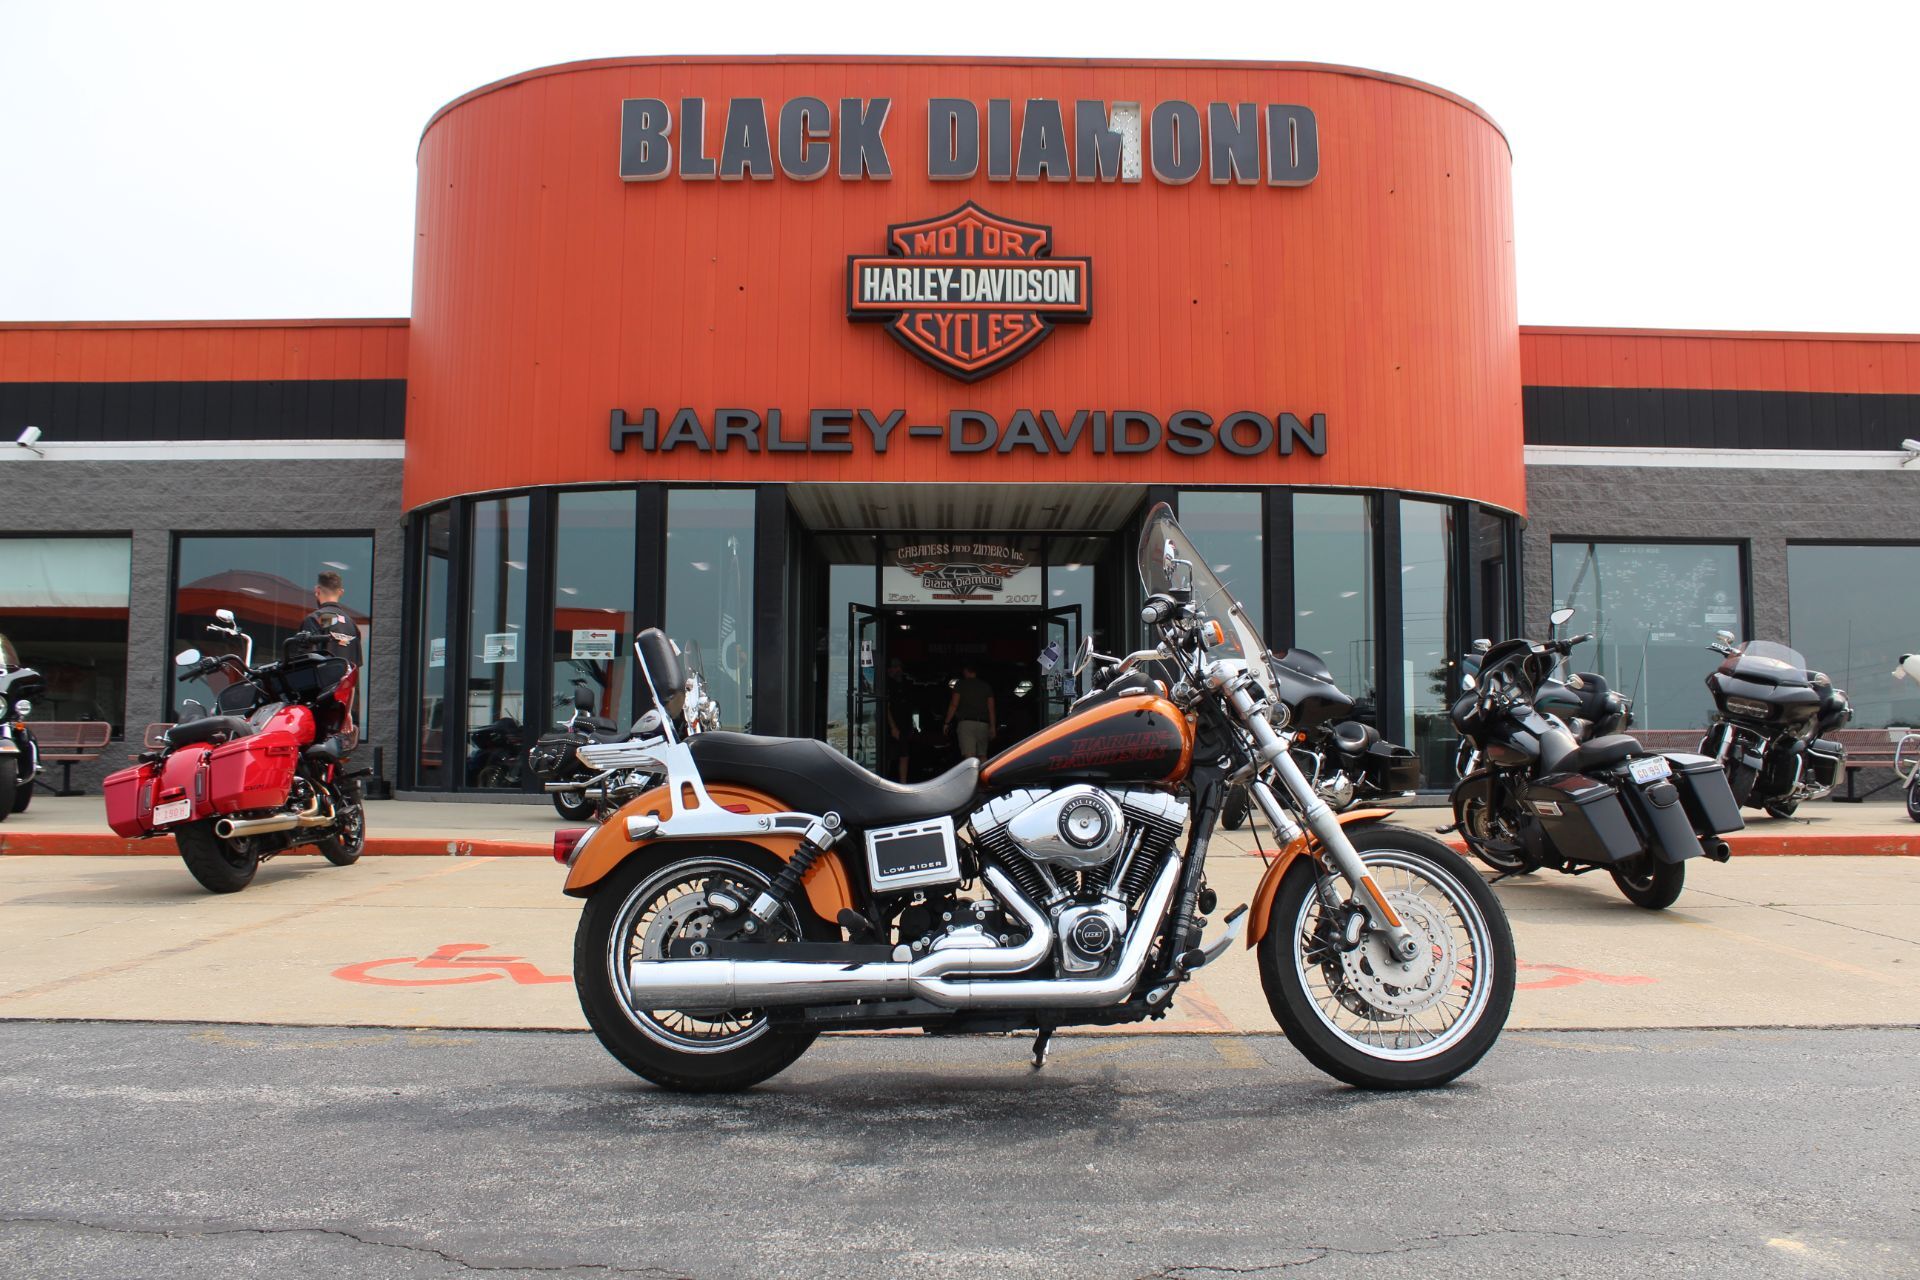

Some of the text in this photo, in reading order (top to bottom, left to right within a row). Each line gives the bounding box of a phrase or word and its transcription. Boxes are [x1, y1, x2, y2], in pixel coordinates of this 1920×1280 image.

[619, 97, 1320, 187] BLACK DIAMOND
[914, 217, 1025, 257] MOTOR
[863, 267, 1077, 304] HARLEY-DAVIDSON
[914, 312, 1025, 361] CYCLES
[608, 408, 1328, 456] HARLEY-DAVIDSON
[1005, 594, 1038, 603] 2007
[883, 861, 942, 874] LOW RIDER
